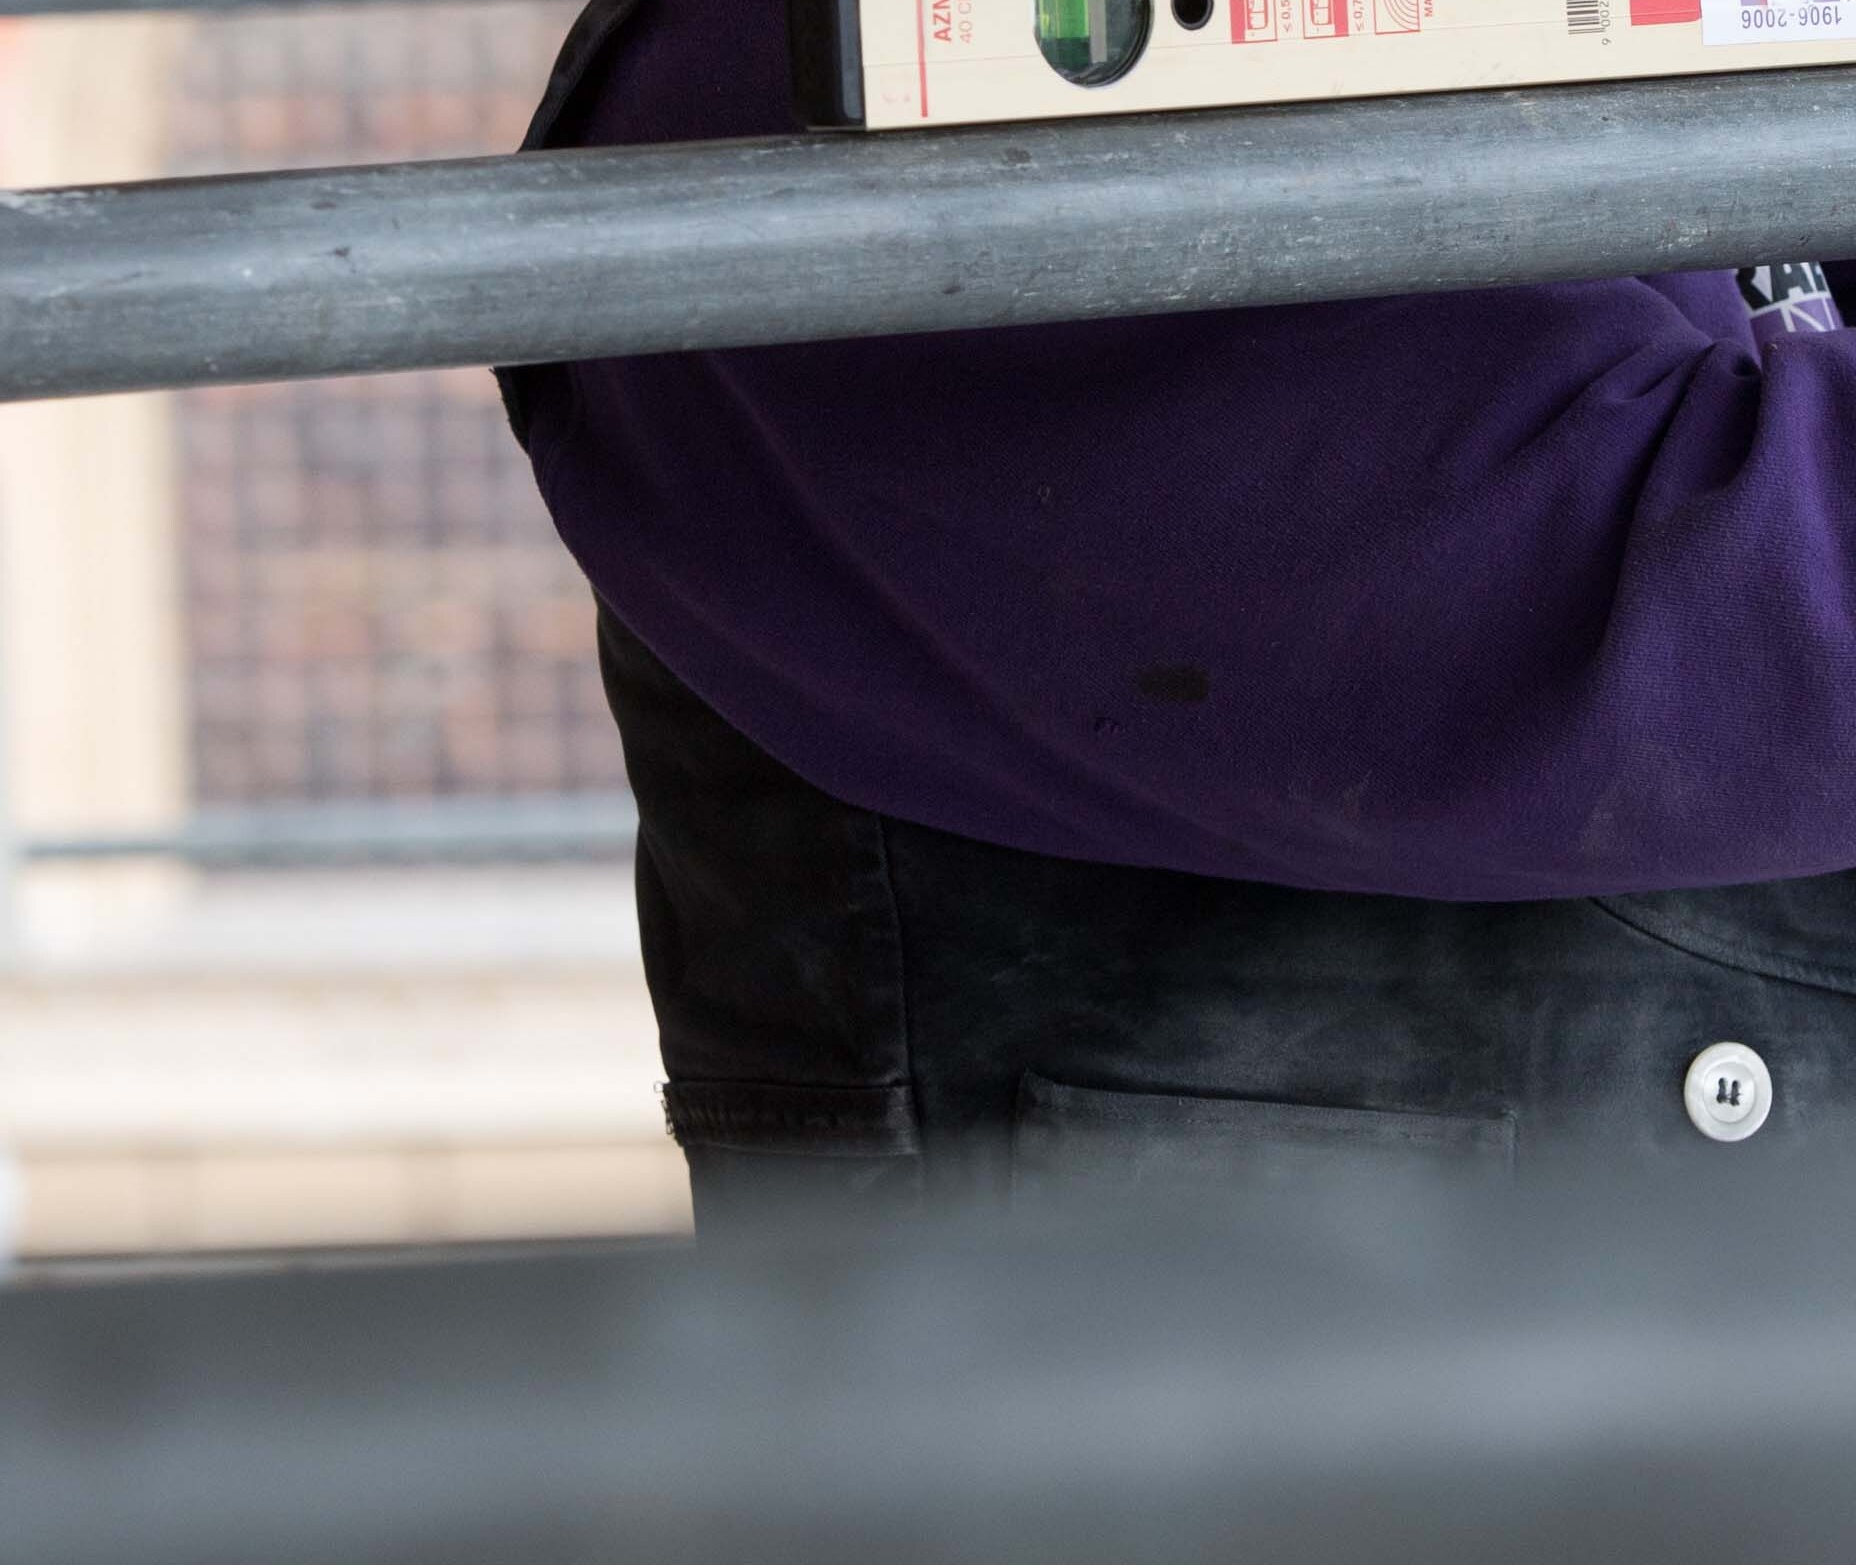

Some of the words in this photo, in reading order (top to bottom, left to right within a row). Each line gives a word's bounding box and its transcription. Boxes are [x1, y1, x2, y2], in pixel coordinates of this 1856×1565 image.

[1281, 0, 1291, 20] 0,5
[1741, 5, 1843, 30] 1906-2006
[958, 20, 974, 44] 40
